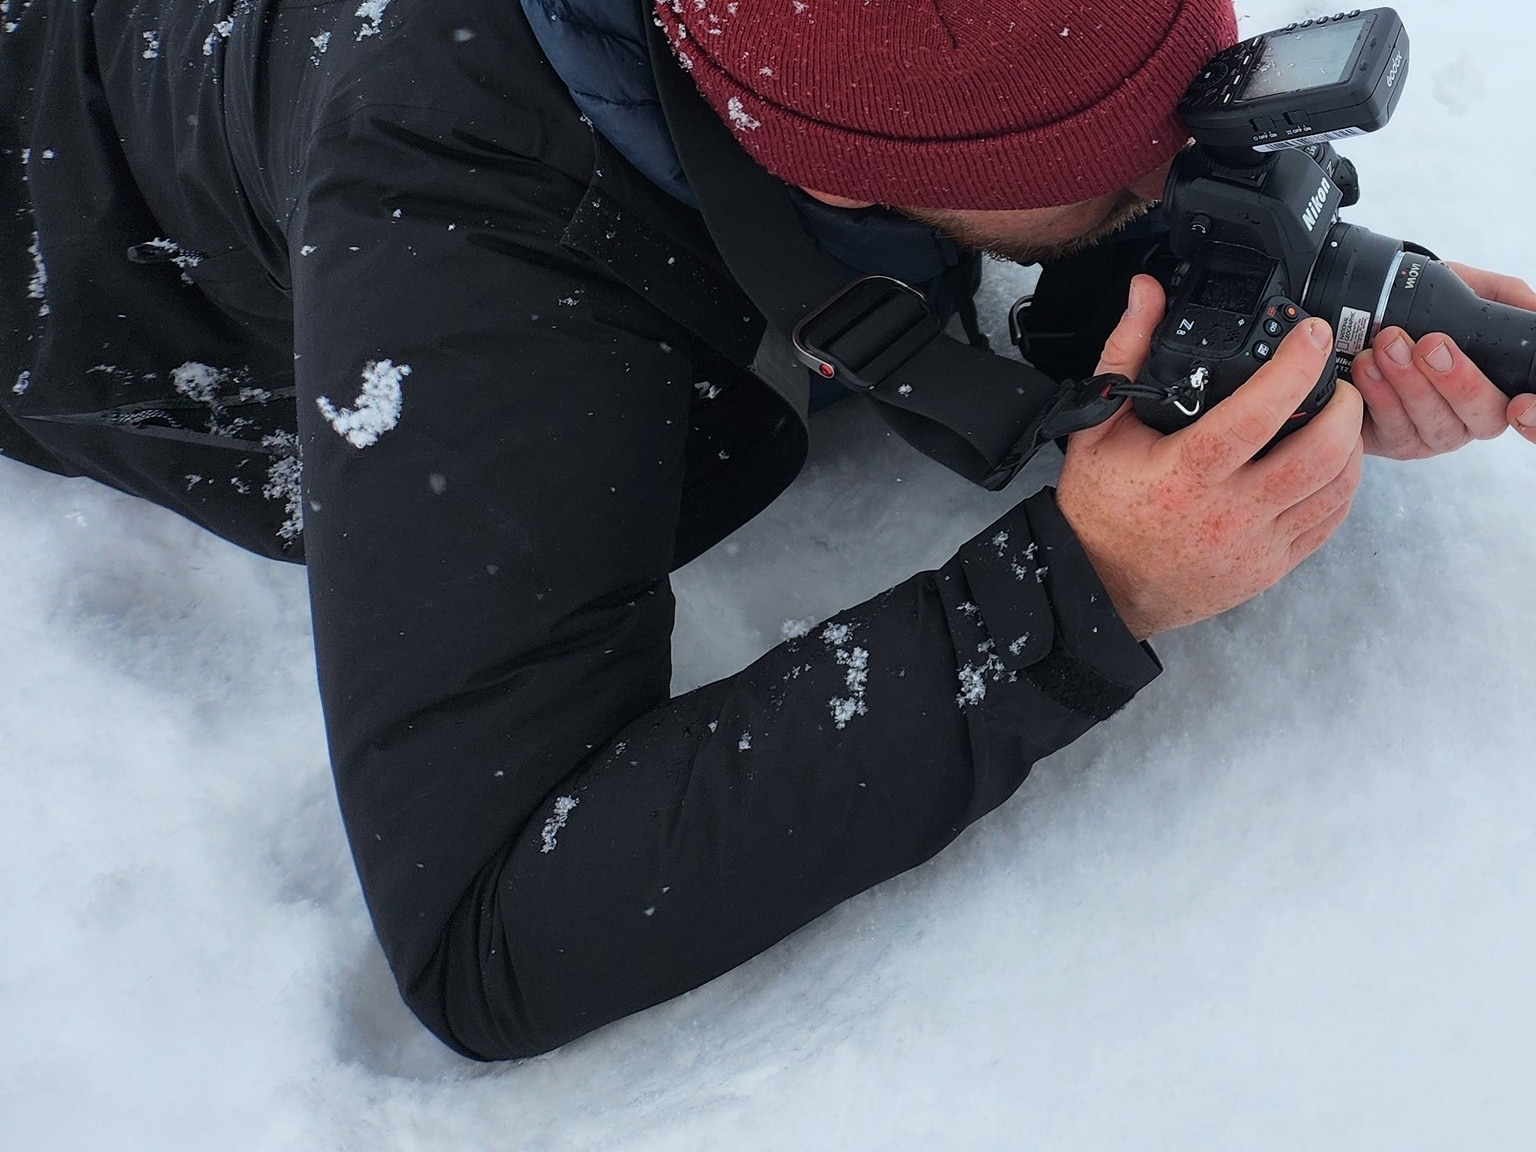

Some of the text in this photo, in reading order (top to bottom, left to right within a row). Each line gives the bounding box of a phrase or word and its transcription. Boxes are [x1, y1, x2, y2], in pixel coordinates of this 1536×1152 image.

[1302, 176, 1331, 232] Nikon
[1340, 316, 1350, 340] NATIONAL
[1345, 311, 1357, 342] GEOGRAPHIC
